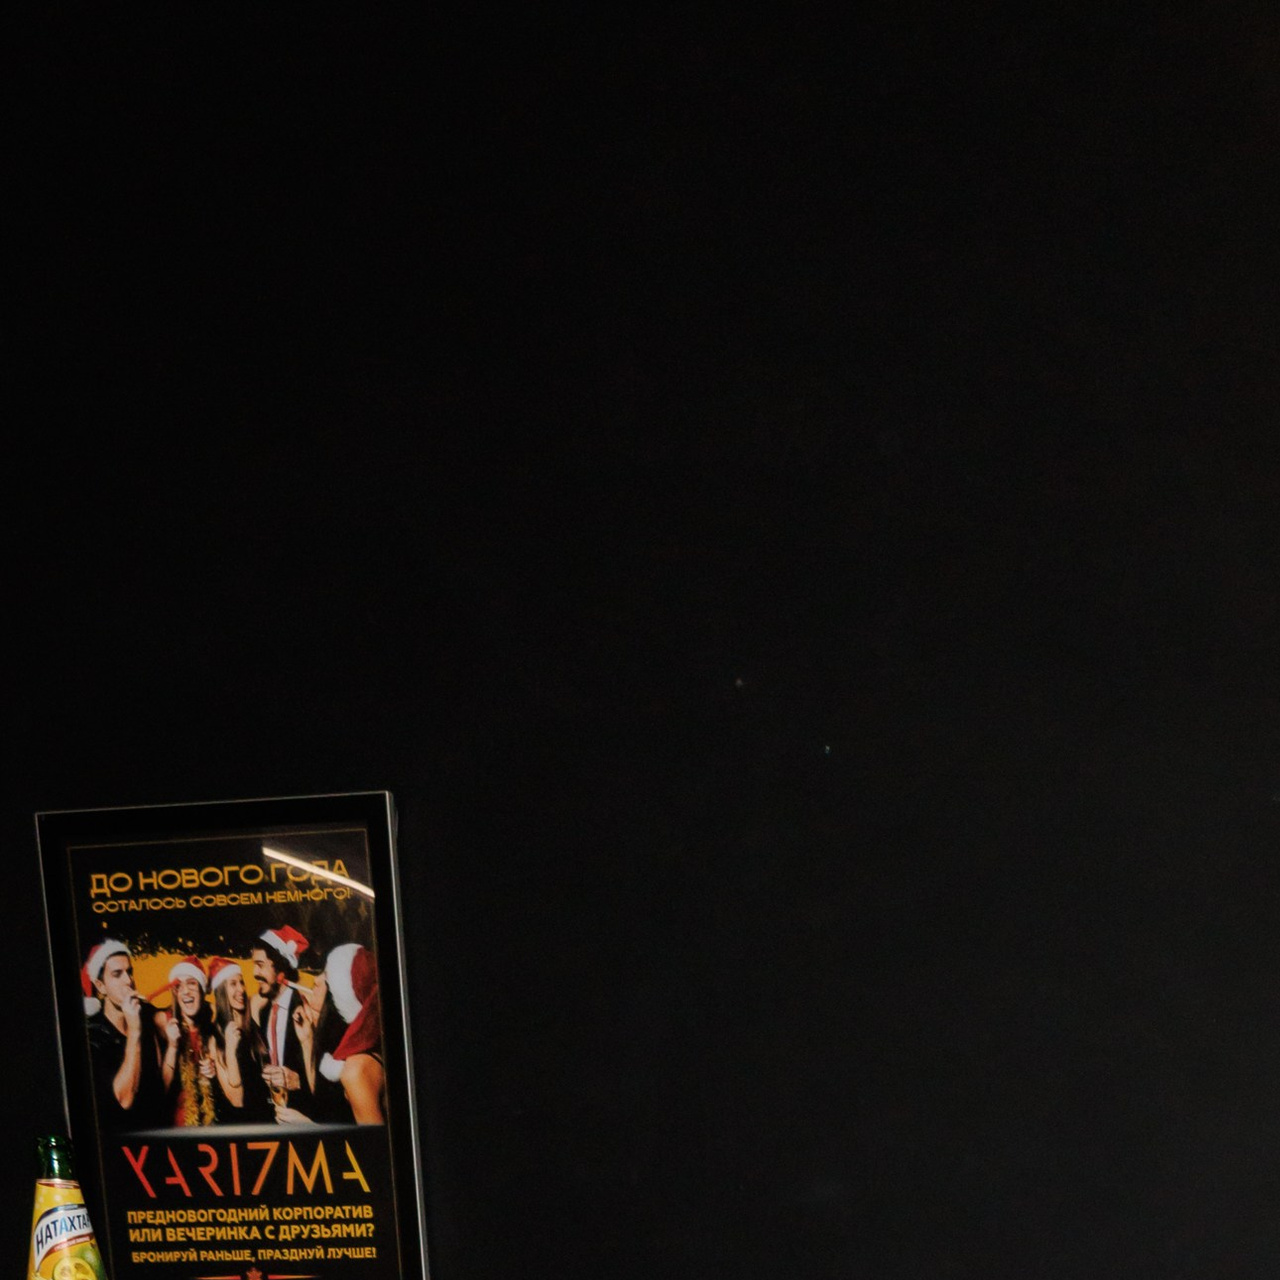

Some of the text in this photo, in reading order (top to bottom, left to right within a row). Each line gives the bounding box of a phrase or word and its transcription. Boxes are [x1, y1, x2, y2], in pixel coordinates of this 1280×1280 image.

[90, 858, 351, 899] ДО НОВОГО ГОДА
[92, 886, 352, 914] ОСТАЛОСЬ СОВСЕМ НЕМНОГО!
[127, 1204, 374, 1226] ПРЕДНОВОГОДНИЙ КОРПОРАТИВ
[129, 1222, 375, 1243] ИЛИ ВЕЧЕРИНКА С ДРУЗЬЯМИ?
[131, 1245, 377, 1264] БРОНИРУЙ РАНЬШЕ, ПРАЗДНУЙ ЛУЧШЕ!
